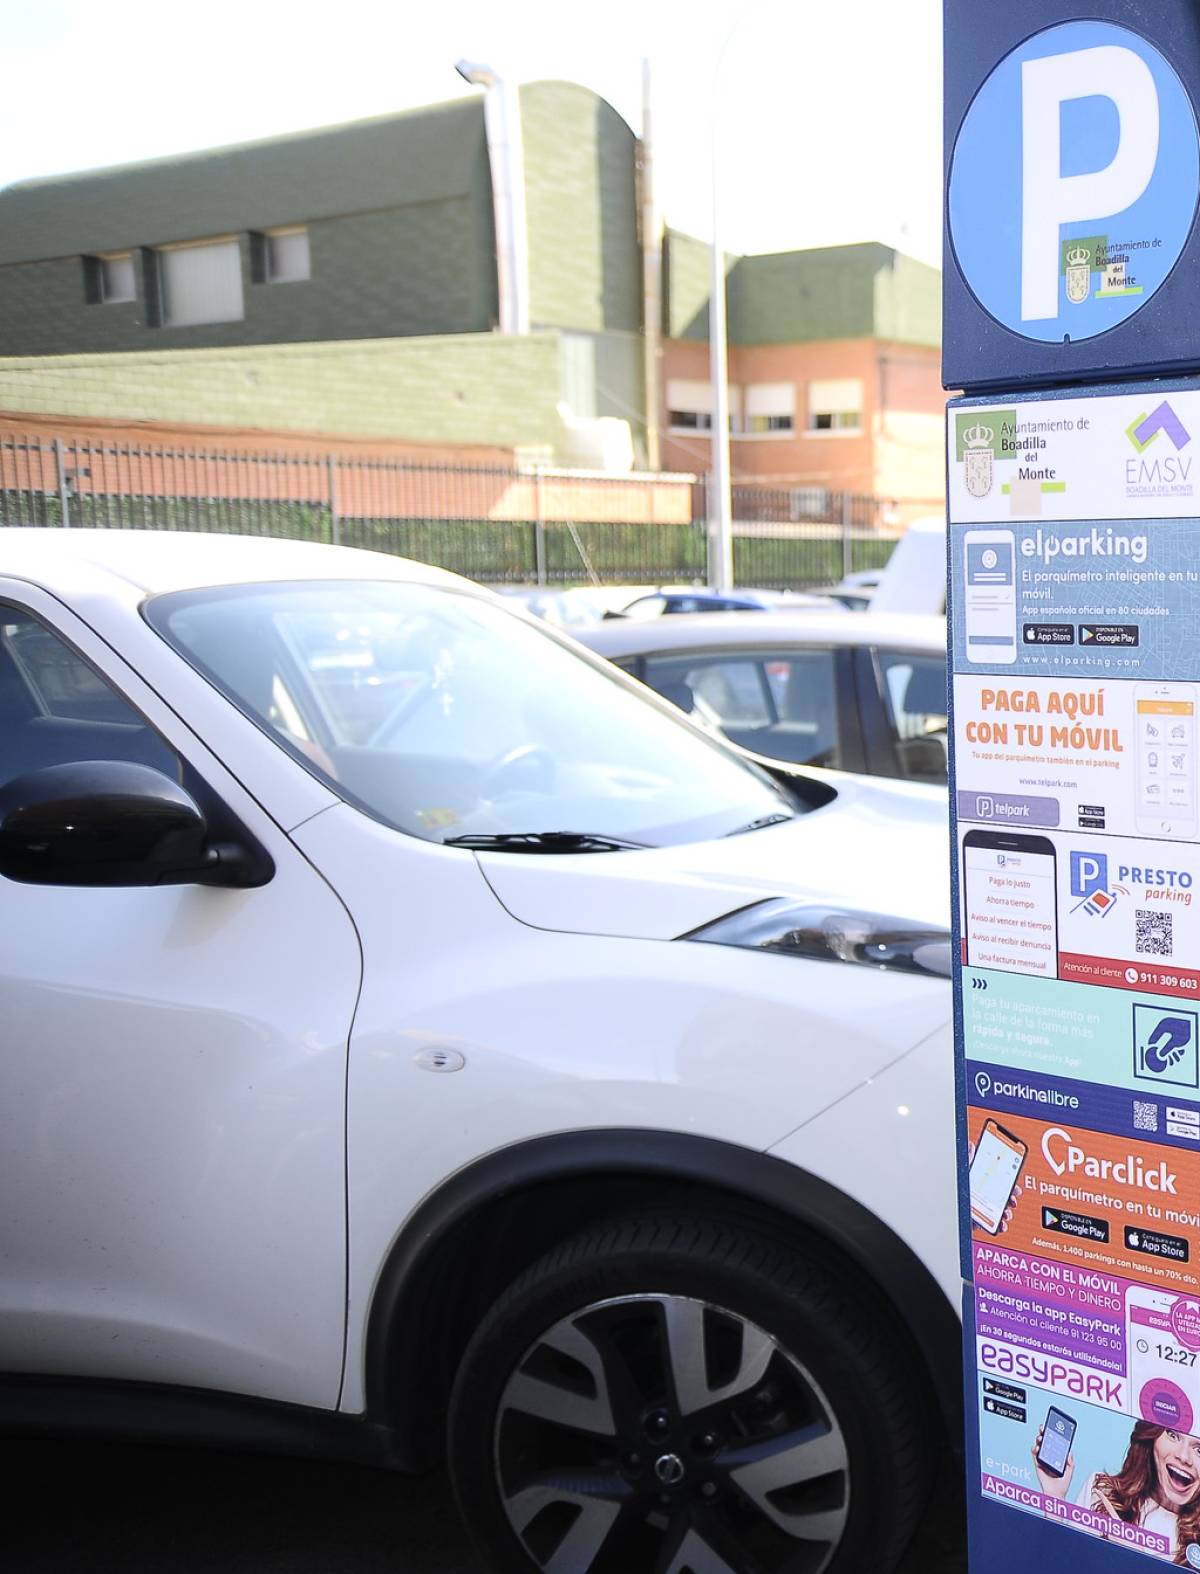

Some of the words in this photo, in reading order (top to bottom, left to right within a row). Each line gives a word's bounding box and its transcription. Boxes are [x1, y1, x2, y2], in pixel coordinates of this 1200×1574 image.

[1021, 45, 1159, 321] P
[1096, 240, 1150, 255] Ayuntamiento
[1151, 238, 1162, 248] de
[1095, 254, 1130, 267] Boadilla
[1107, 275, 1136, 287] Monte
[1001, 418, 1073, 435] Ayuntamiento
[1077, 417, 1090, 429] de
[1001, 437, 1046, 451] Boadilla
[1025, 452, 1037, 462] del
[1018, 467, 1056, 480] Monte
[1126, 457, 1192, 483] EMSV
[1126, 485, 1155, 493] BOADILLA
[1156, 485, 1169, 493] DEL
[1171, 484, 1193, 492] MONTE
[1021, 528, 1147, 564] elparking
[1022, 570, 1031, 581] El
[1035, 570, 1103, 584] parquímetro
[1106, 570, 1165, 584] inteligente
[1169, 573, 1183, 581] en
[1186, 571, 1198, 581] tu
[1023, 588, 1054, 600] móvil.
[1022, 606, 1038, 616] App
[1040, 606, 1076, 616] española
[1079, 606, 1104, 615] oficial
[1118, 606, 1129, 615] 80
[1037, 633, 1051, 642] App
[1053, 633, 1071, 642] Store
[1096, 634, 1119, 643] Google
[1121, 634, 1135, 644] Play
[1023, 656, 1140, 668] www.elparking.com
[981, 689, 1041, 712] PAGA
[1047, 689, 1104, 720] AQUÍ
[966, 722, 1008, 745] CON
[1014, 724, 1043, 746] TU
[1050, 722, 1123, 752] MÓVIL
[981, 753, 992, 761] app
[994, 752, 1004, 760] del
[1006, 752, 1045, 765] parquímetro
[1047, 755, 1073, 765] también
[1085, 758, 1091, 766] el
[1093, 759, 1120, 769] parking
[1019, 777, 1077, 789] www.telpark.com
[995, 802, 1030, 817] telpark
[989, 876, 1004, 887] Paga
[1006, 878, 1012, 887] lo
[1013, 879, 1031, 889] justo
[1080, 856, 1099, 892] P
[1119, 866, 1192, 888] PRESTO
[987, 895, 1007, 905] Ahorra
[1009, 898, 1035, 909] tiempo
[1145, 888, 1192, 906] parking
[971, 913, 988, 924] Aviso
[989, 915, 995, 926] al
[997, 918, 1021, 928] vencer
[1027, 919, 1052, 931] tiempo
[972, 932, 989, 943] Aviso
[990, 934, 996, 944] al
[998, 935, 1019, 947] recibir
[1021, 938, 1051, 951] denuncia
[978, 952, 992, 962] Una
[993, 954, 1016, 966] factura
[1017, 958, 1046, 969] mensual
[1064, 961, 1093, 974] Atención
[1094, 966, 1099, 975] al
[1100, 967, 1122, 979] cliente
[1140, 972, 1157, 984] 911
[1160, 975, 1177, 986] 309
[1180, 977, 1198, 989] 603
[972, 992, 996, 1009] Paga
[999, 998, 1010, 1009] tu
[1013, 1001, 1084, 1021] aparcamiento
[1087, 1014, 1100, 1024] en
[973, 1008, 982, 1019] la
[983, 1010, 1008, 1024] calle
[1010, 1016, 1024, 1026] de
[1025, 1017, 1035, 1028] la
[1038, 1020, 1068, 1034] forma
[1071, 1024, 1094, 1039] más
[1006, 1031, 1012, 1041] y
[1068, 1146, 1177, 1194] Parclick
[1024, 1175, 1036, 1190] El
[1040, 1182, 1123, 1210] parquímetro
[1126, 1201, 1144, 1215] en
[1146, 1204, 1161, 1218] tu
[1061, 1220, 1088, 1236] Google
[1089, 1226, 1106, 1239] Play
[1142, 1239, 1160, 1252] App
[1161, 1244, 1185, 1258] Store
[976, 1248, 1028, 1271] APARCA
[1031, 1261, 1060, 1280] CON
[1063, 1270, 1076, 1284] EL
[1079, 1271, 1121, 1296] MÓVIL
[1084, 1250, 1116, 1265] parkings
[1117, 1258, 1131, 1267] con
[1132, 1261, 1152, 1273] hasta
[1153, 1267, 1164, 1275] un
[1165, 1269, 1181, 1281] 70%
[1183, 1273, 1199, 1285] dto.
[977, 1264, 1022, 1285] AHORRA
[1025, 1276, 1065, 1297] TIEMPO
[1068, 1286, 1076, 1298] Y
[1078, 1290, 1121, 1311] DINERO
[979, 1288, 1030, 1312] Descarga
[1032, 1300, 1042, 1314] la
[1047, 1308, 1067, 1322] app
[1069, 1312, 1121, 1337] EasyPark
[990, 1306, 1028, 1324] Atención
[1030, 1316, 1038, 1327] al
[1039, 1319, 1069, 1335] cliente
[1081, 1330, 1094, 1342] 123
[1110, 1339, 1122, 1351] 00
[992, 1326, 1002, 1337] 30
[1004, 1329, 1041, 1348] segundos
[1042, 1339, 1073, 1356] estarás
[1073, 1349, 1123, 1371] utilizándola!
[1156, 1344, 1197, 1367] 12:27
[995, 1386, 1014, 1399] Google
[1014, 1391, 1024, 1402] Play
[996, 1405, 1006, 1415] App
[1007, 1408, 1024, 1421] Store
[985, 1456, 1032, 1482] e-park
[985, 1476, 1041, 1508] Aparca
[1045, 1496, 1068, 1518] sin
[1071, 1508, 1166, 1552] comisiones
